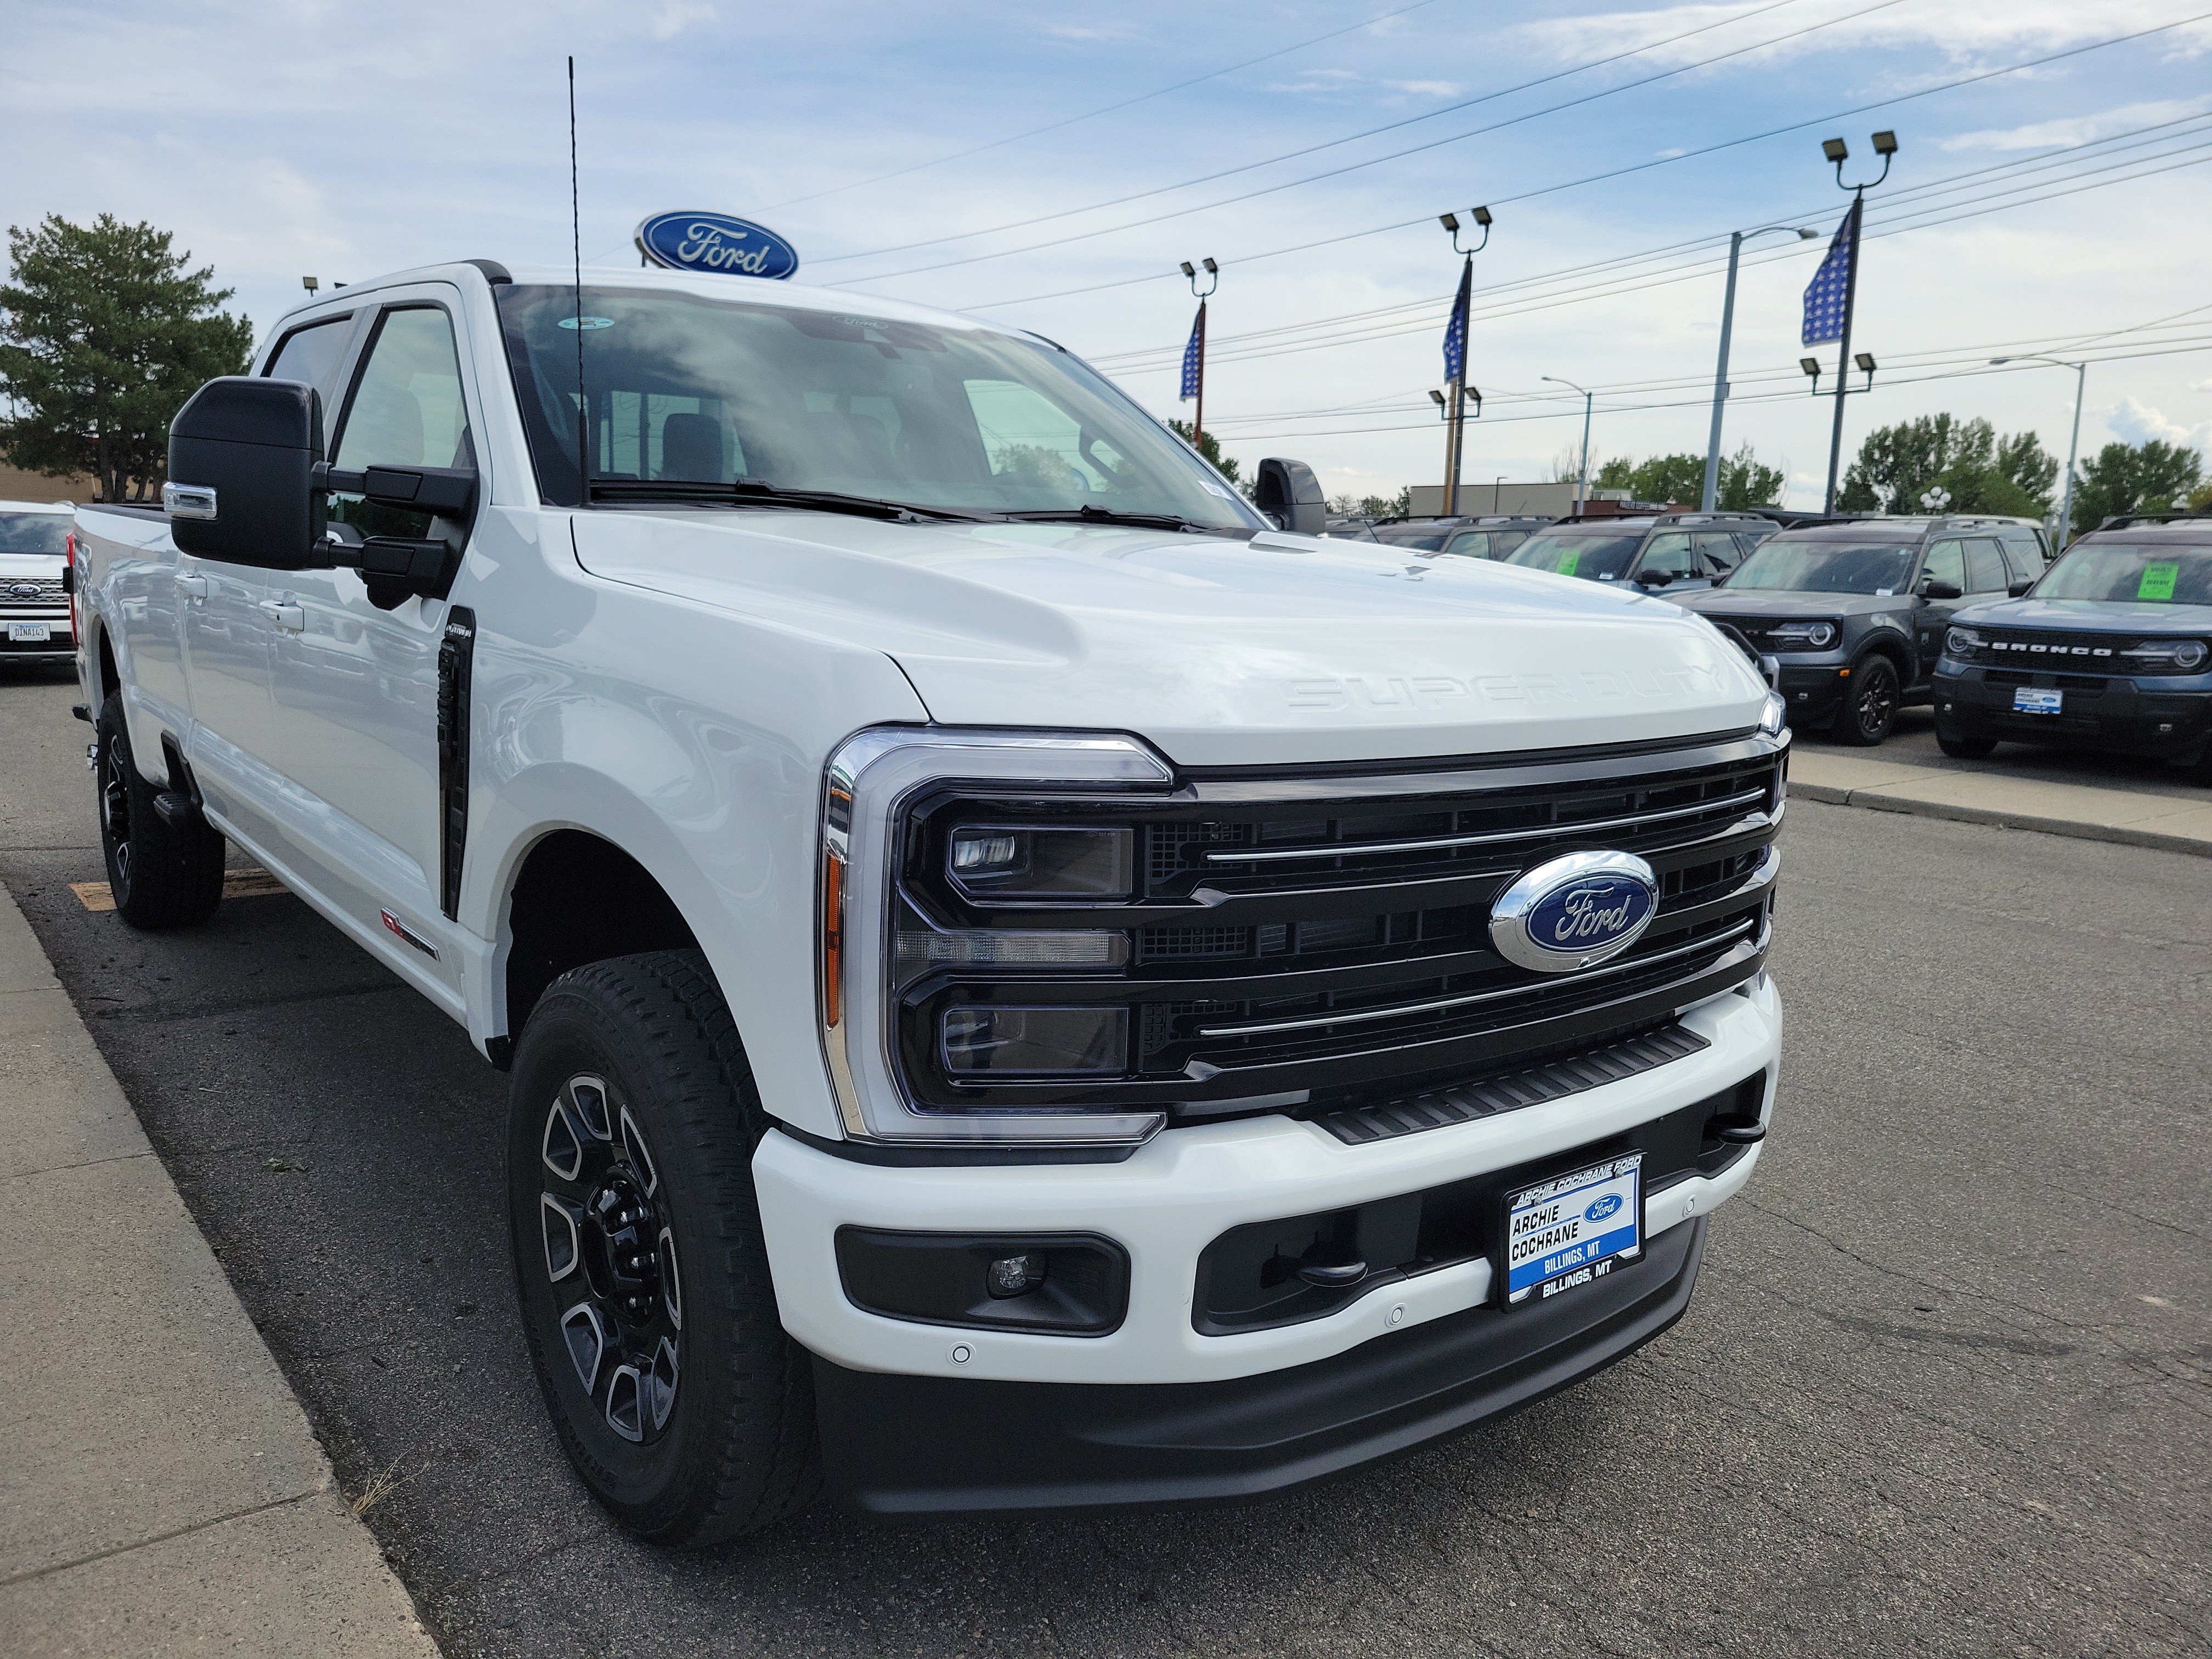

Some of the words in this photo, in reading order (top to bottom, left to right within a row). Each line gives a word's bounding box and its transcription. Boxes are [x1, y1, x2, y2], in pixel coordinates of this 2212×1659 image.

[678, 222, 770, 274] Ford
[15, 628, 44, 636] DINA143
[1991, 641, 2112, 657] BRONCO
[1281, 673, 1576, 713] SUPER
[1579, 663, 1726, 701] DUTY
[1555, 886, 1632, 941] Ford
[1516, 1183, 1557, 1206] ARCHIE
[1556, 1164, 1613, 1191] COCHRANE
[1613, 1155, 1642, 1172] FORD
[1513, 1204, 1560, 1237] ARCHIE
[1592, 1197, 1616, 1219] Ford
[1512, 1221, 1578, 1261] COCHRANE
[1544, 1247, 1585, 1274] BILLINGS,
[1587, 1240, 1600, 1258] MT
[1543, 1268, 1593, 1299] BILLINGS,
[1595, 1260, 1612, 1277] MT
